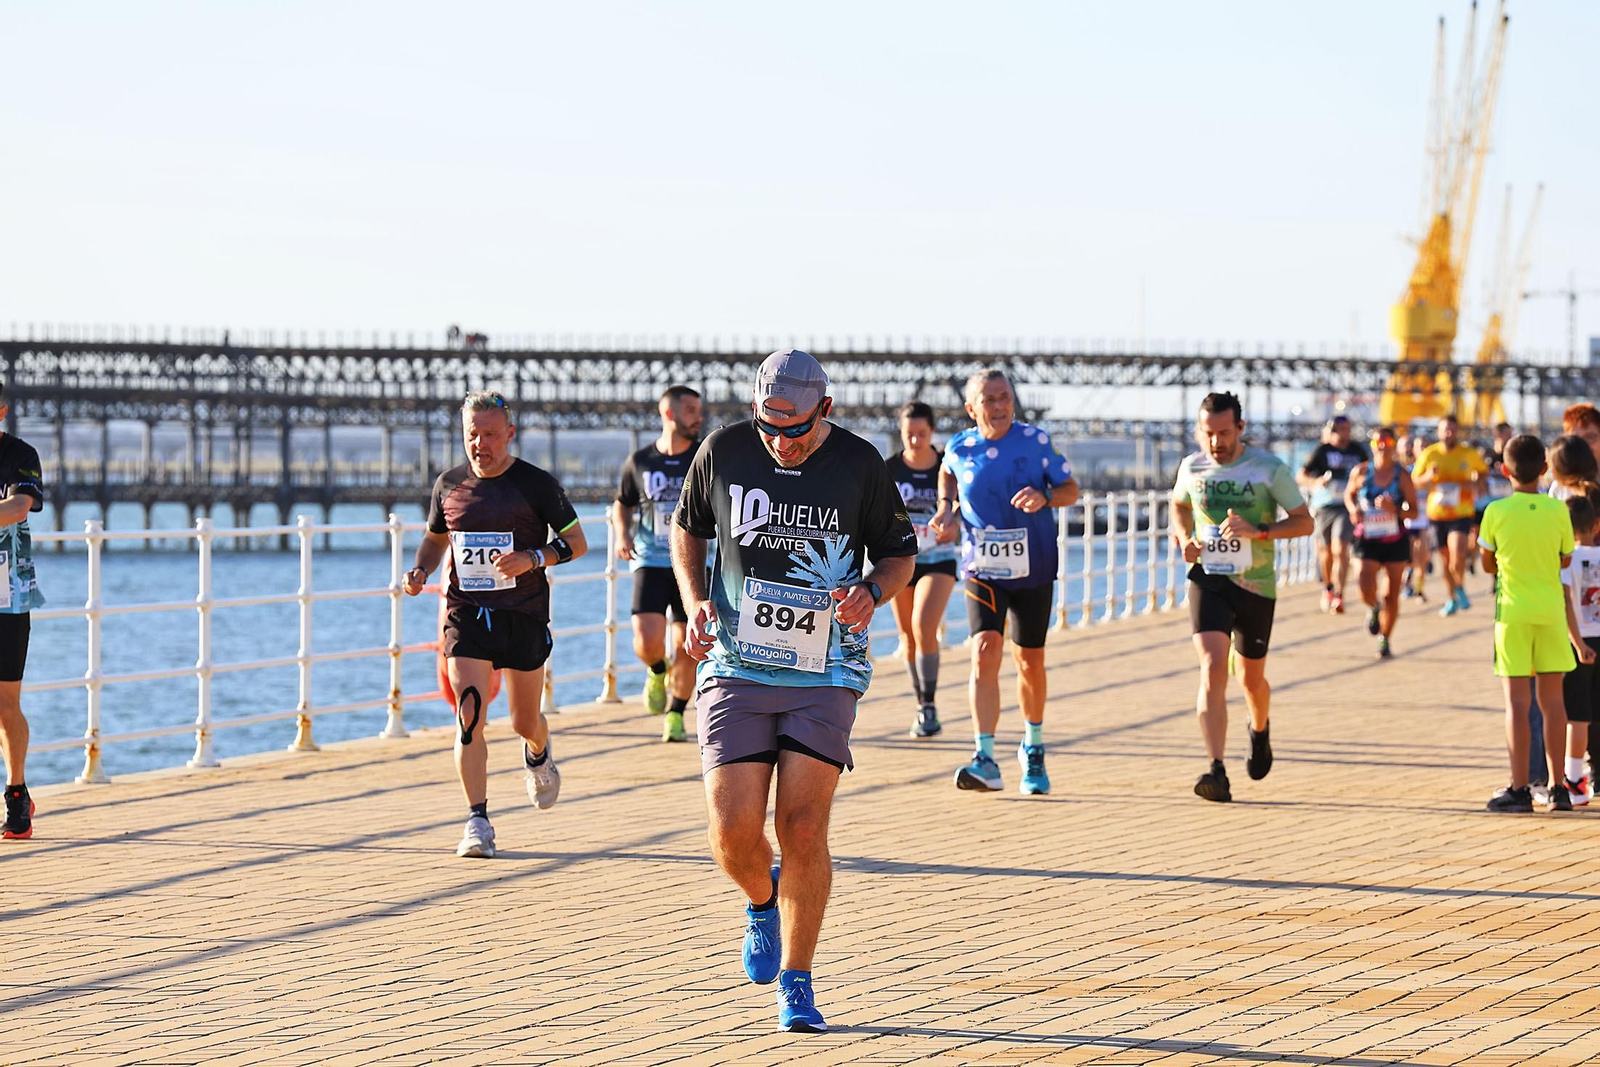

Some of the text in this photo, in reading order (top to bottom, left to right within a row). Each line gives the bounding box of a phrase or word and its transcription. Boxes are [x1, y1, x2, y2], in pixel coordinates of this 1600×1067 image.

[729, 483, 840, 546] 10 HUELVA
[767, 525, 839, 540] PUERTA DEL DESCUBRIMIENTO
[979, 541, 1024, 557] 1019
[1207, 539, 1241, 553] 869
[761, 585, 781, 597] HUELVA
[783, 591, 812, 603] AVATEL
[754, 603, 816, 635] 894
